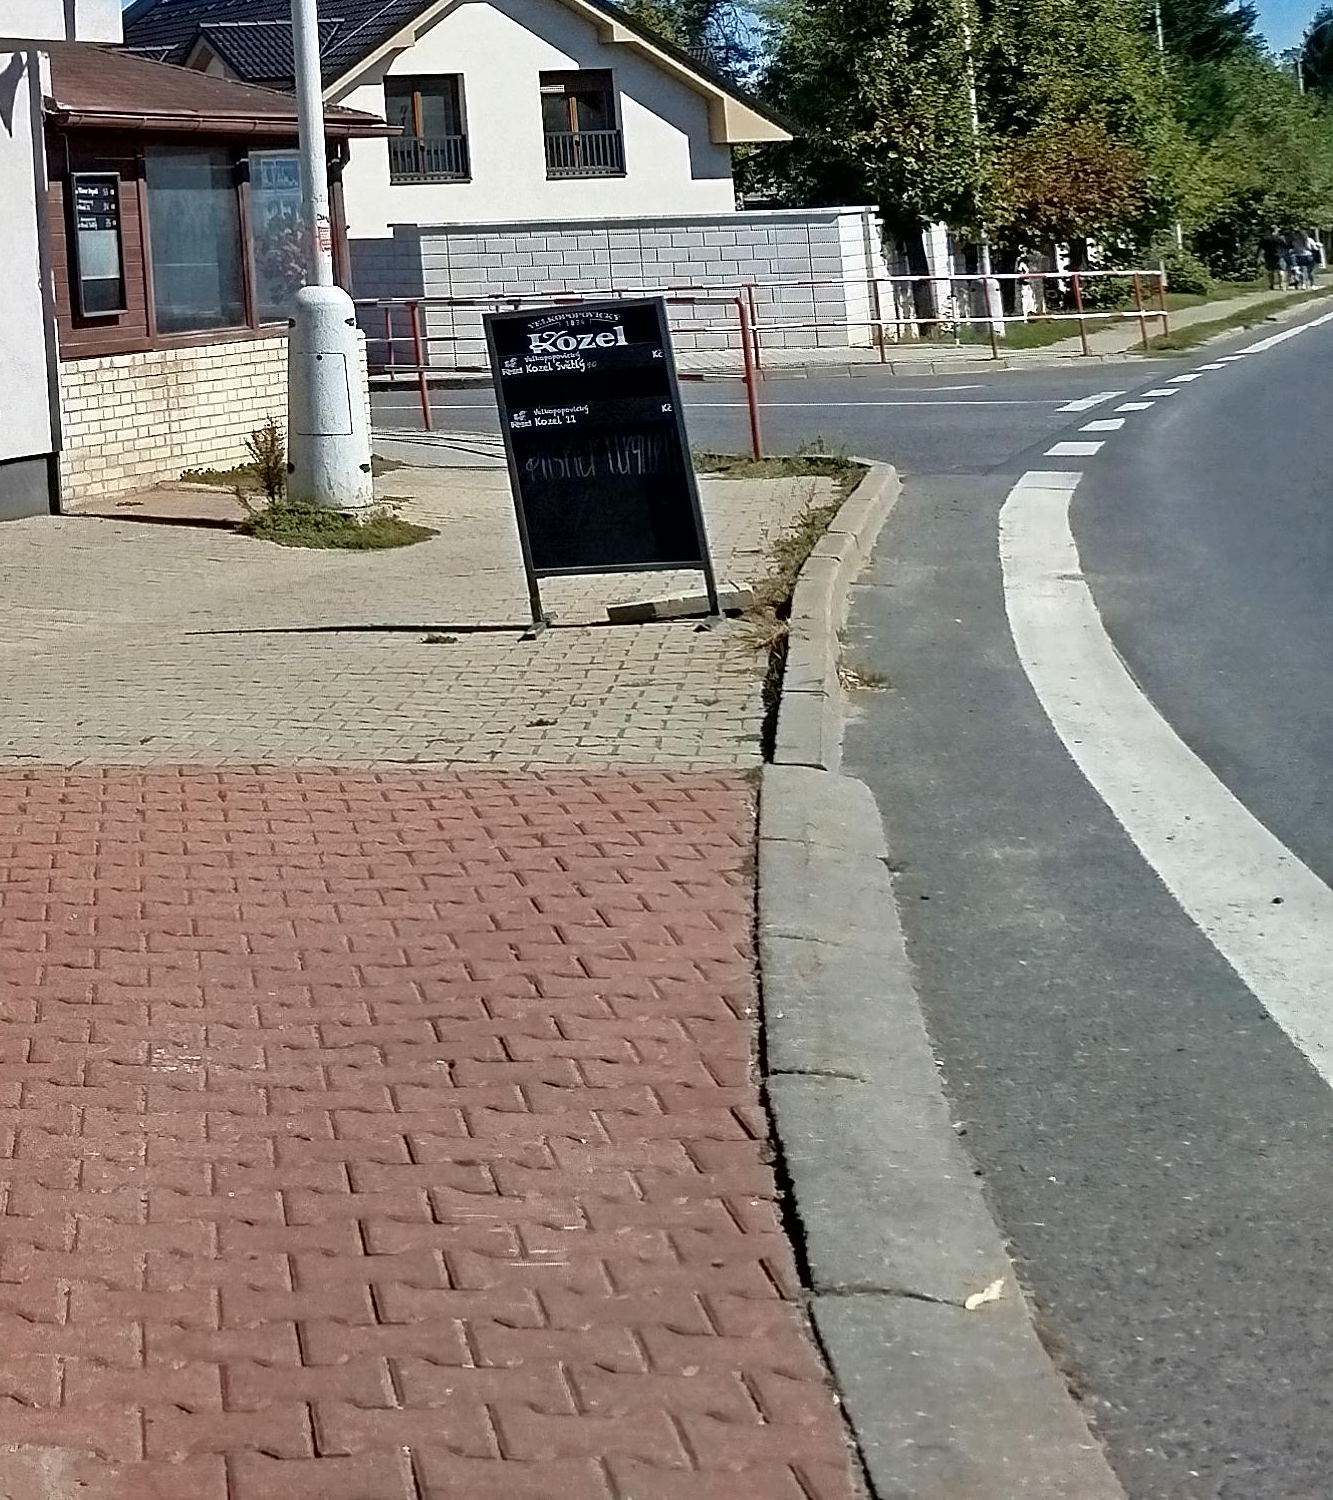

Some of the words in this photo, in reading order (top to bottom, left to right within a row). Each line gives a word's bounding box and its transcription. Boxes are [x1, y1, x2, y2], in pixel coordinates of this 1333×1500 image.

[526, 325, 629, 354] Kozel
[526, 362, 553, 373] Kozel
[534, 415, 563, 426] Kozel
